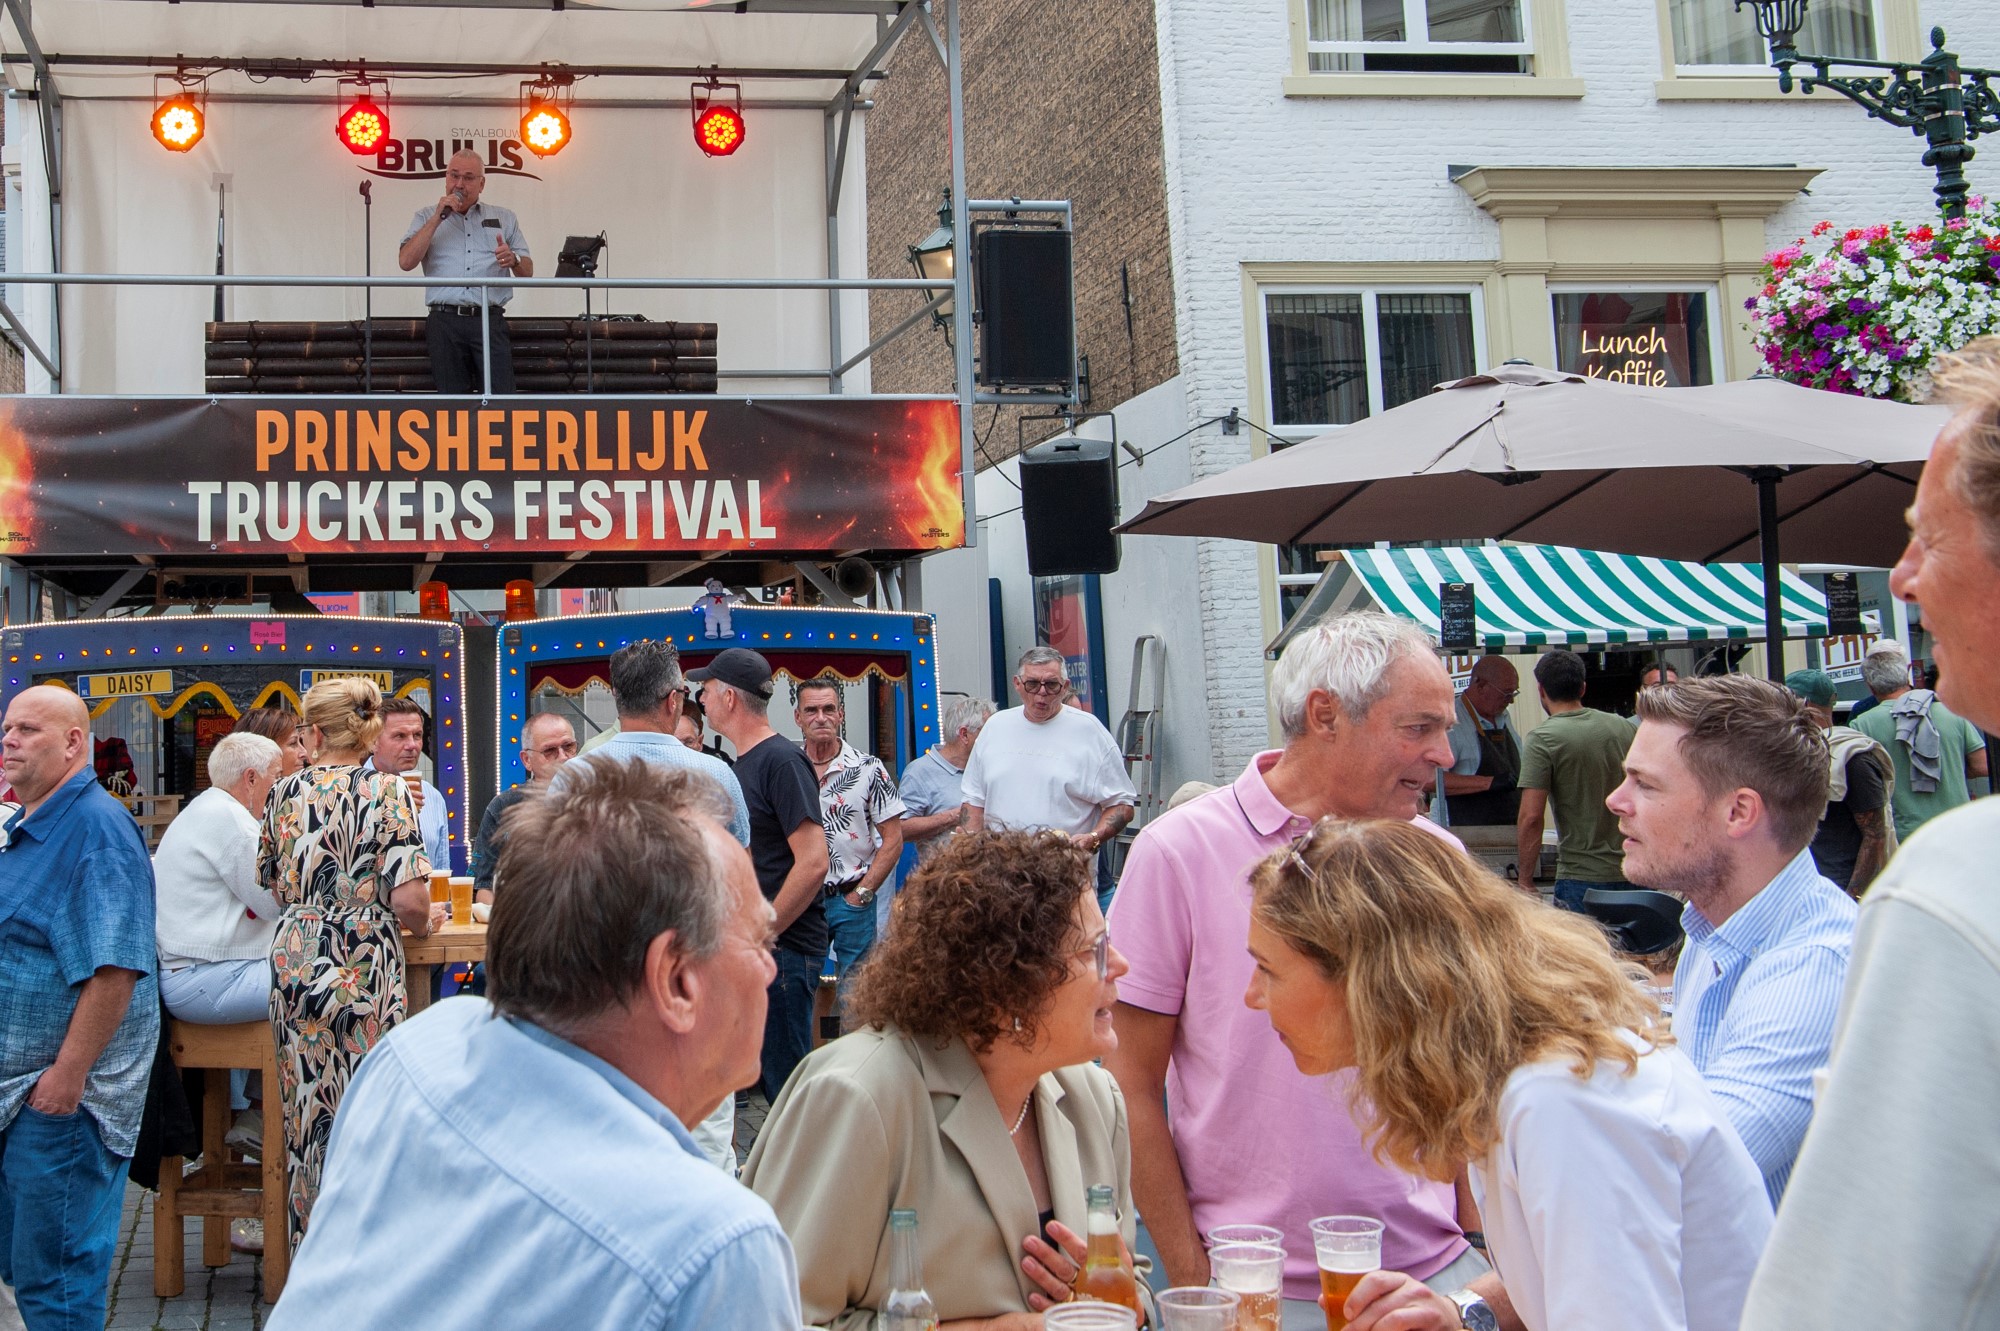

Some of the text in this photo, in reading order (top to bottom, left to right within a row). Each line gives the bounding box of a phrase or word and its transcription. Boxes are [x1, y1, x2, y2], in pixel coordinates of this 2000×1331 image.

[1582, 326, 1668, 355] Lunch
[1587, 360, 1668, 388] Koffie
[256, 409, 710, 472] PRINSHEERLIJK
[188, 479, 777, 542] TRUCKERS FESTIVAL
[317, 604, 349, 612] LKOM
[107, 674, 154, 694] DAISY
